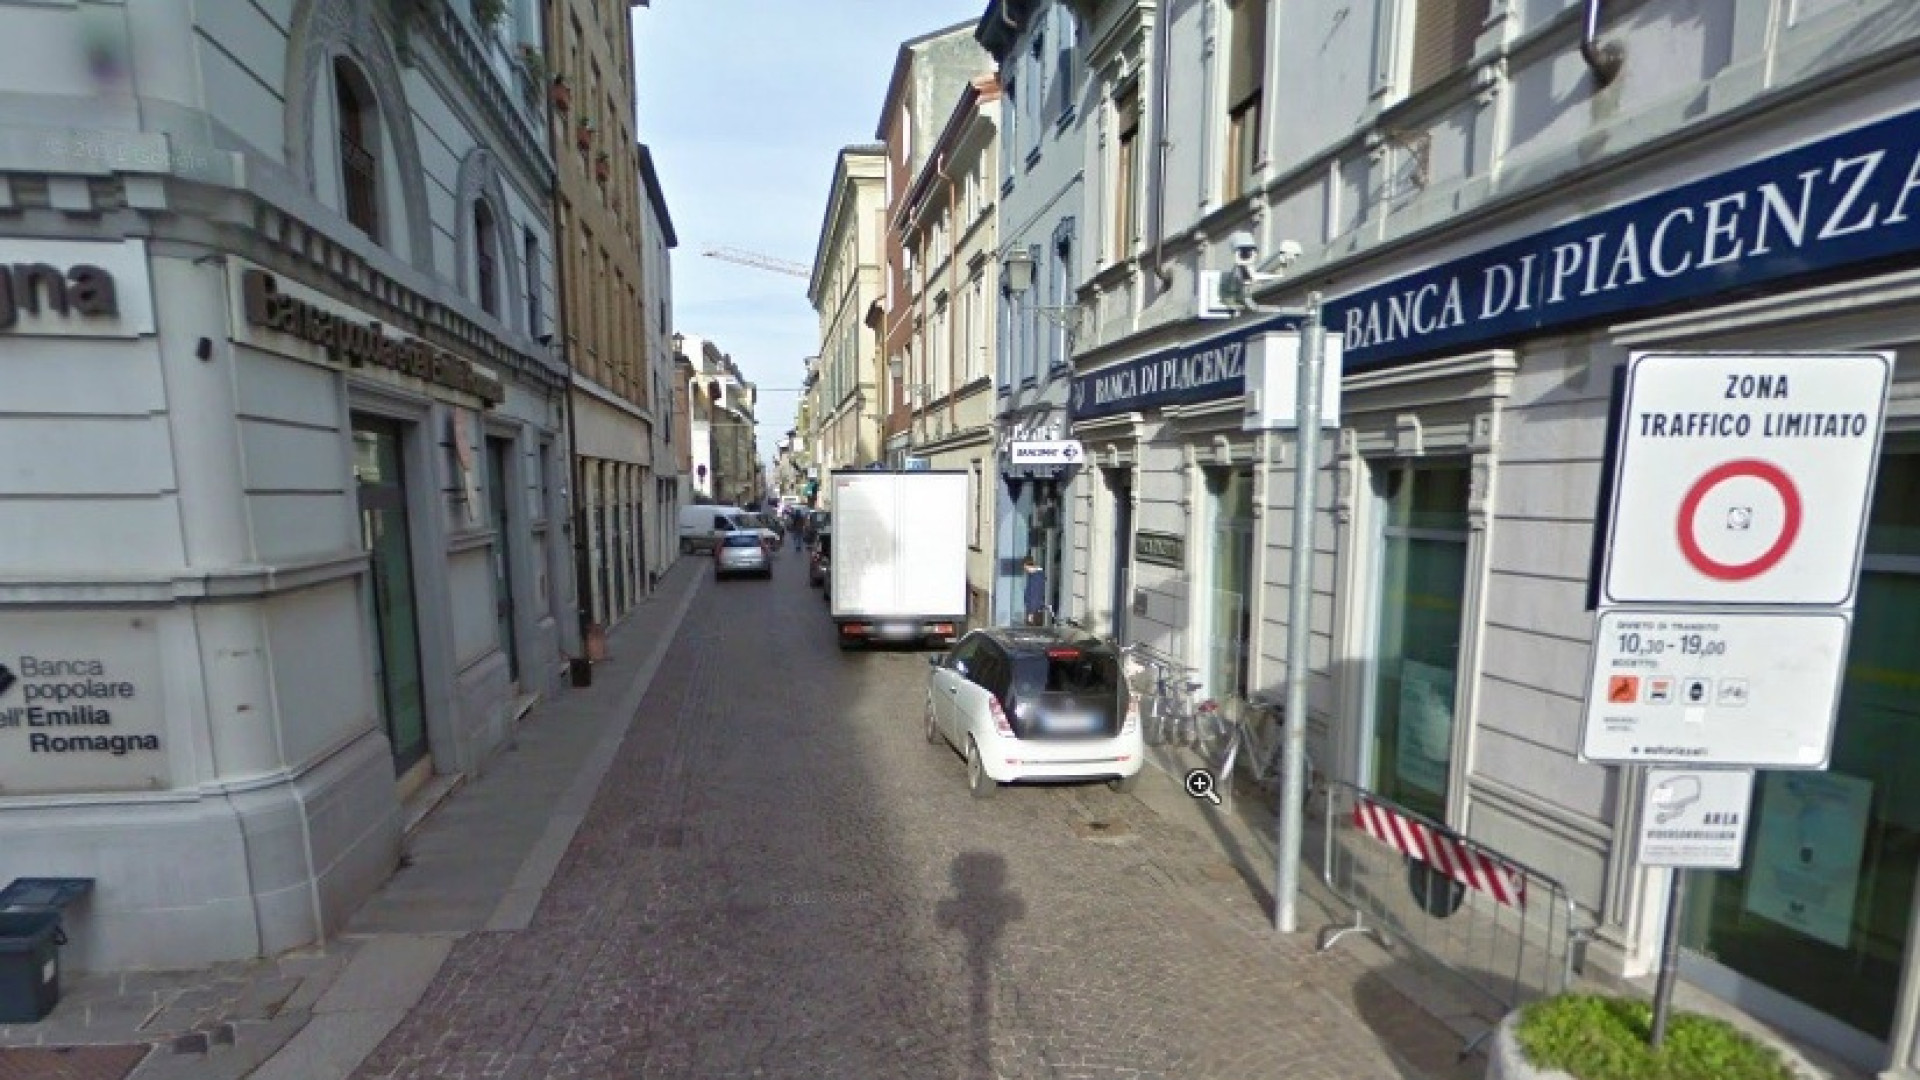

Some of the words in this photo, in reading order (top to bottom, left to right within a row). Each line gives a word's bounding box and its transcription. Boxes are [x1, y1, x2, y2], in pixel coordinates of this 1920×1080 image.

[1344, 276, 1465, 350] BANCA
[1478, 253, 1537, 320] DI
[1095, 369, 1137, 406] BANCA
[1139, 362, 1160, 396] DI
[1160, 341, 1244, 391] PIACENZ
[1724, 374, 1789, 399] ZONA
[1640, 412, 1751, 438] TRAFFICO
[1762, 412, 1868, 438] LIMITATO
[20, 655, 104, 676] Banca
[23, 677, 136, 703] popolare
[29, 732, 159, 756] Romagna
